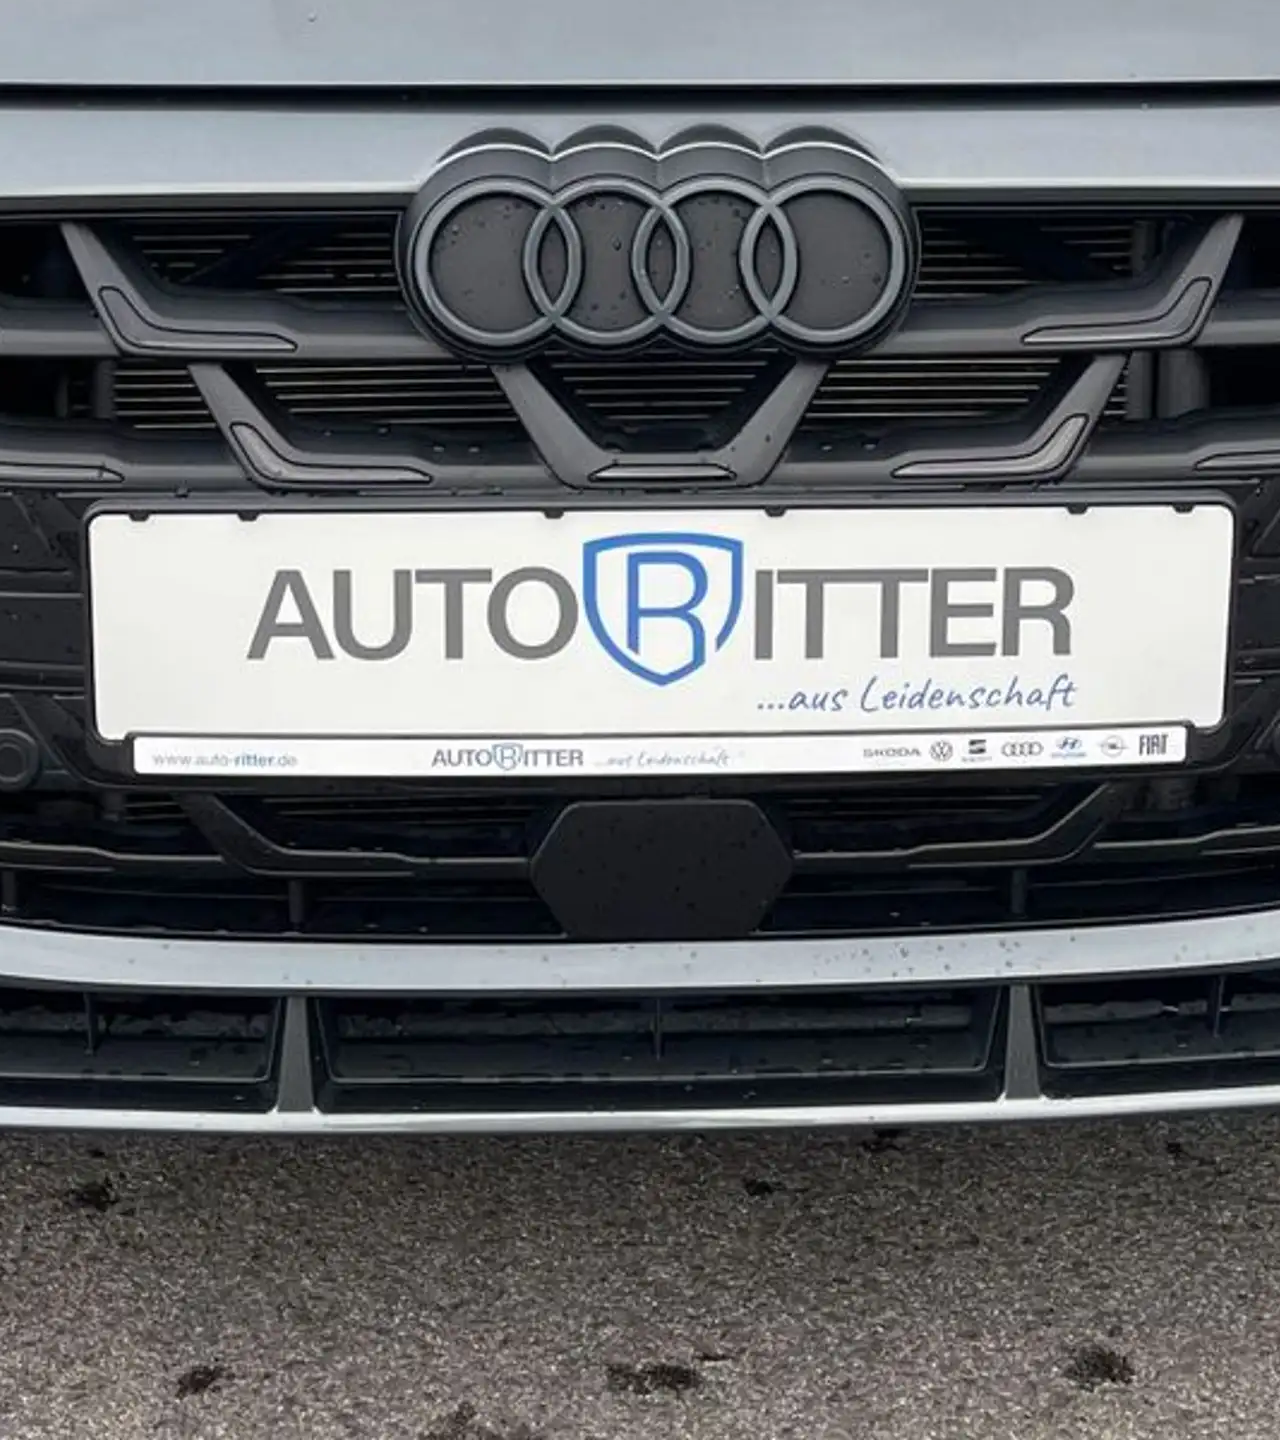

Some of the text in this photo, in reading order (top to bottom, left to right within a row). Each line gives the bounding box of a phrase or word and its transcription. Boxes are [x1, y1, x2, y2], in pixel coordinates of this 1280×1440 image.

[246, 565, 580, 662] AUTO
[757, 673, 1078, 712] ...aus Leidenschaft
[1138, 734, 1169, 757] FIAT
[152, 752, 298, 767] www.auto-ritter.de
[431, 748, 492, 768] AUTO
